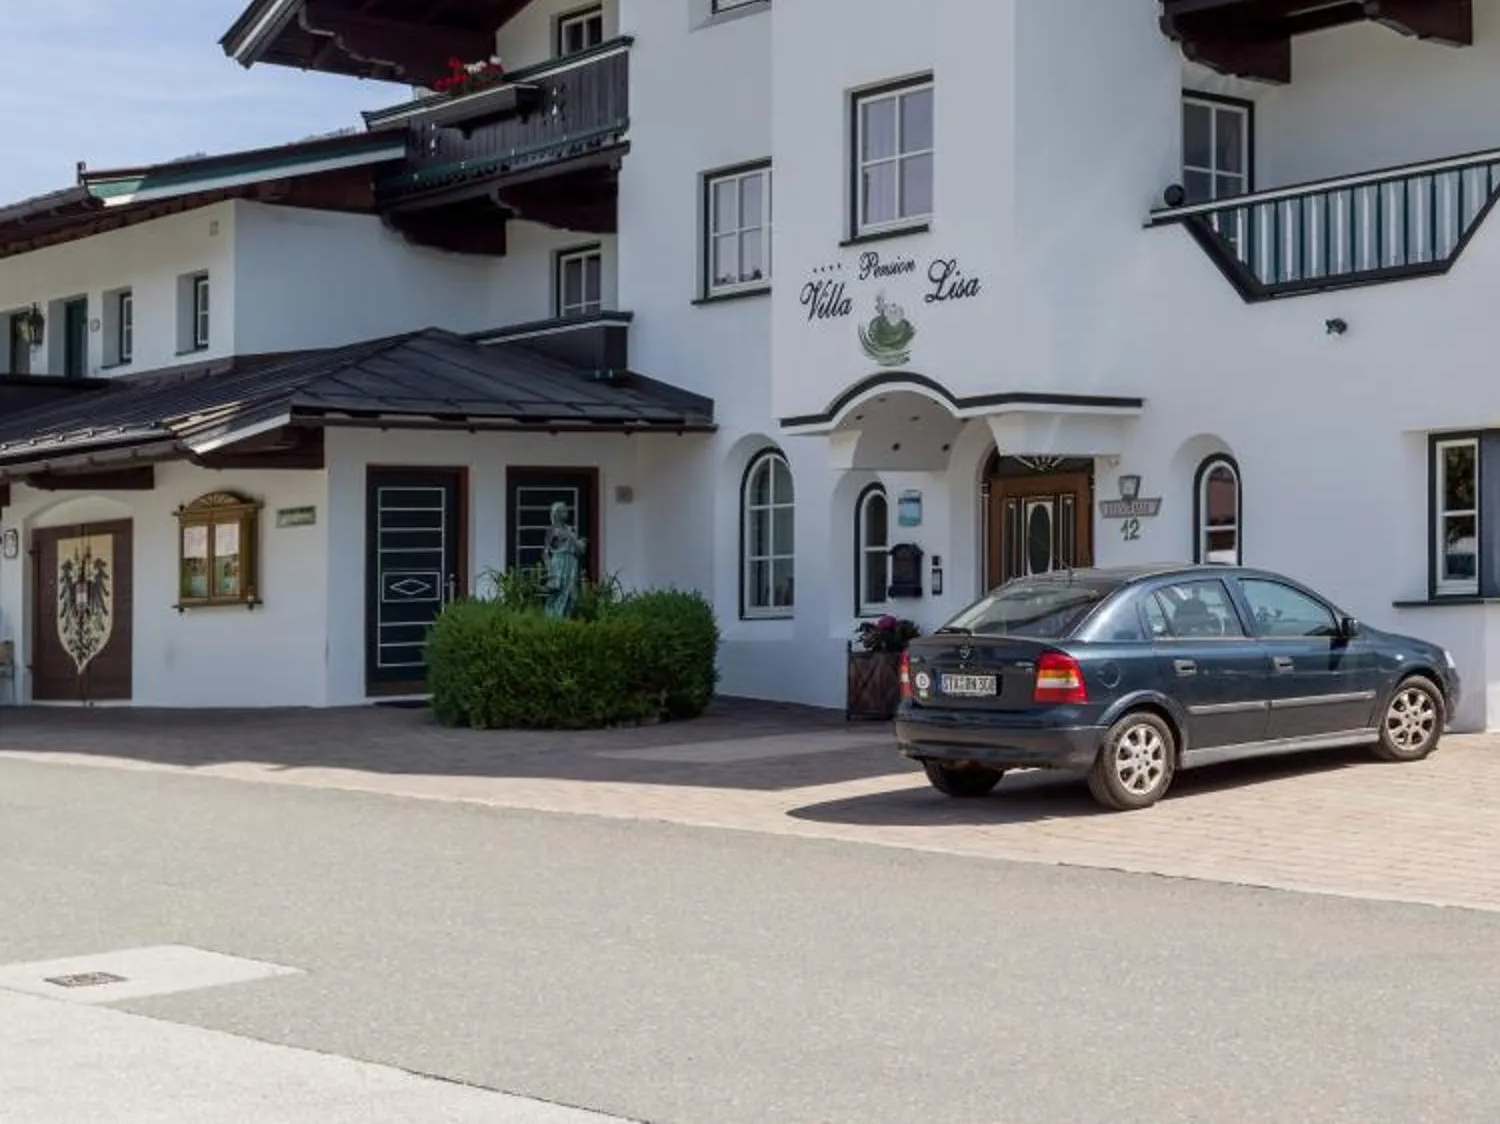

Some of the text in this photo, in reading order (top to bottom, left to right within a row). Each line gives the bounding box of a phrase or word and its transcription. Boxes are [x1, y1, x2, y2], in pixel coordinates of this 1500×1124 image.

[859, 251, 917, 281] Pension
[800, 258, 982, 322] Villa Lisa
[1120, 518, 1141, 541] 12
